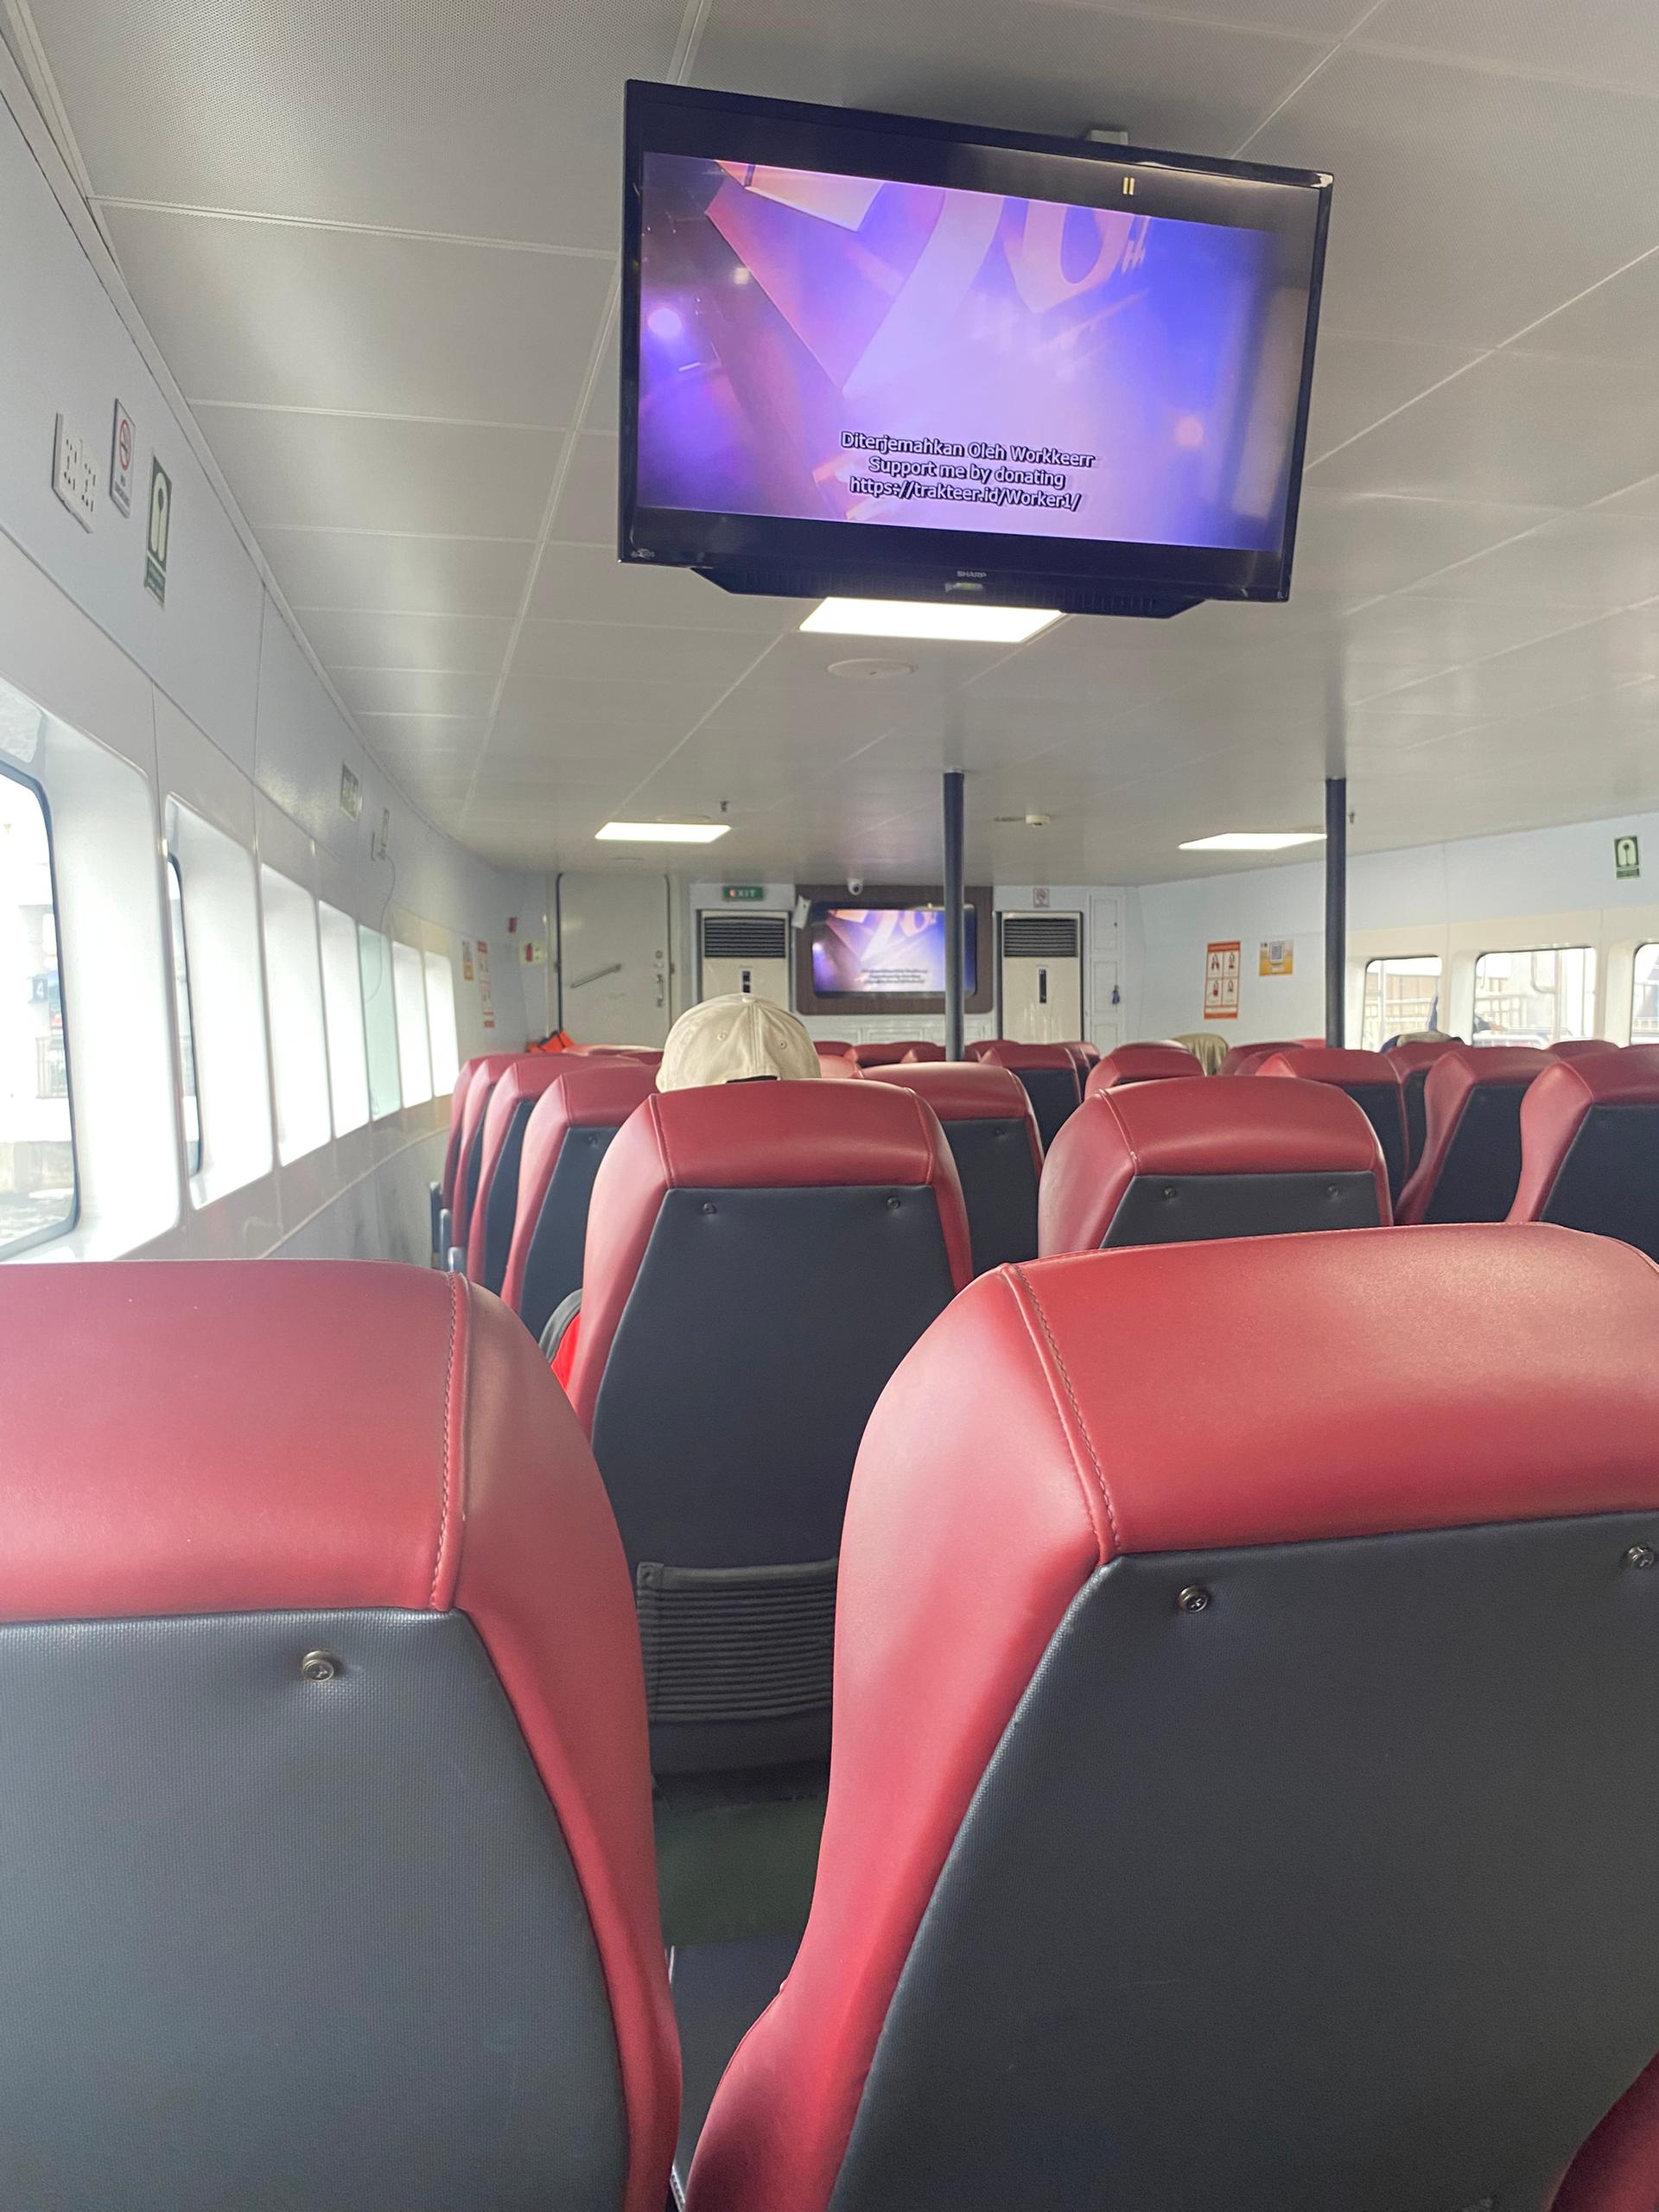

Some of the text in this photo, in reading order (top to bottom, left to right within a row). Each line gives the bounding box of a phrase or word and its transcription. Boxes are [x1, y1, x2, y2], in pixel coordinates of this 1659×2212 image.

[842, 431, 1096, 467] Diterjemahkan Oleh Workkeerr
[868, 456, 1065, 490] Support me by donating
[850, 476, 1082, 512] https://trakteer.id/Worker1/
